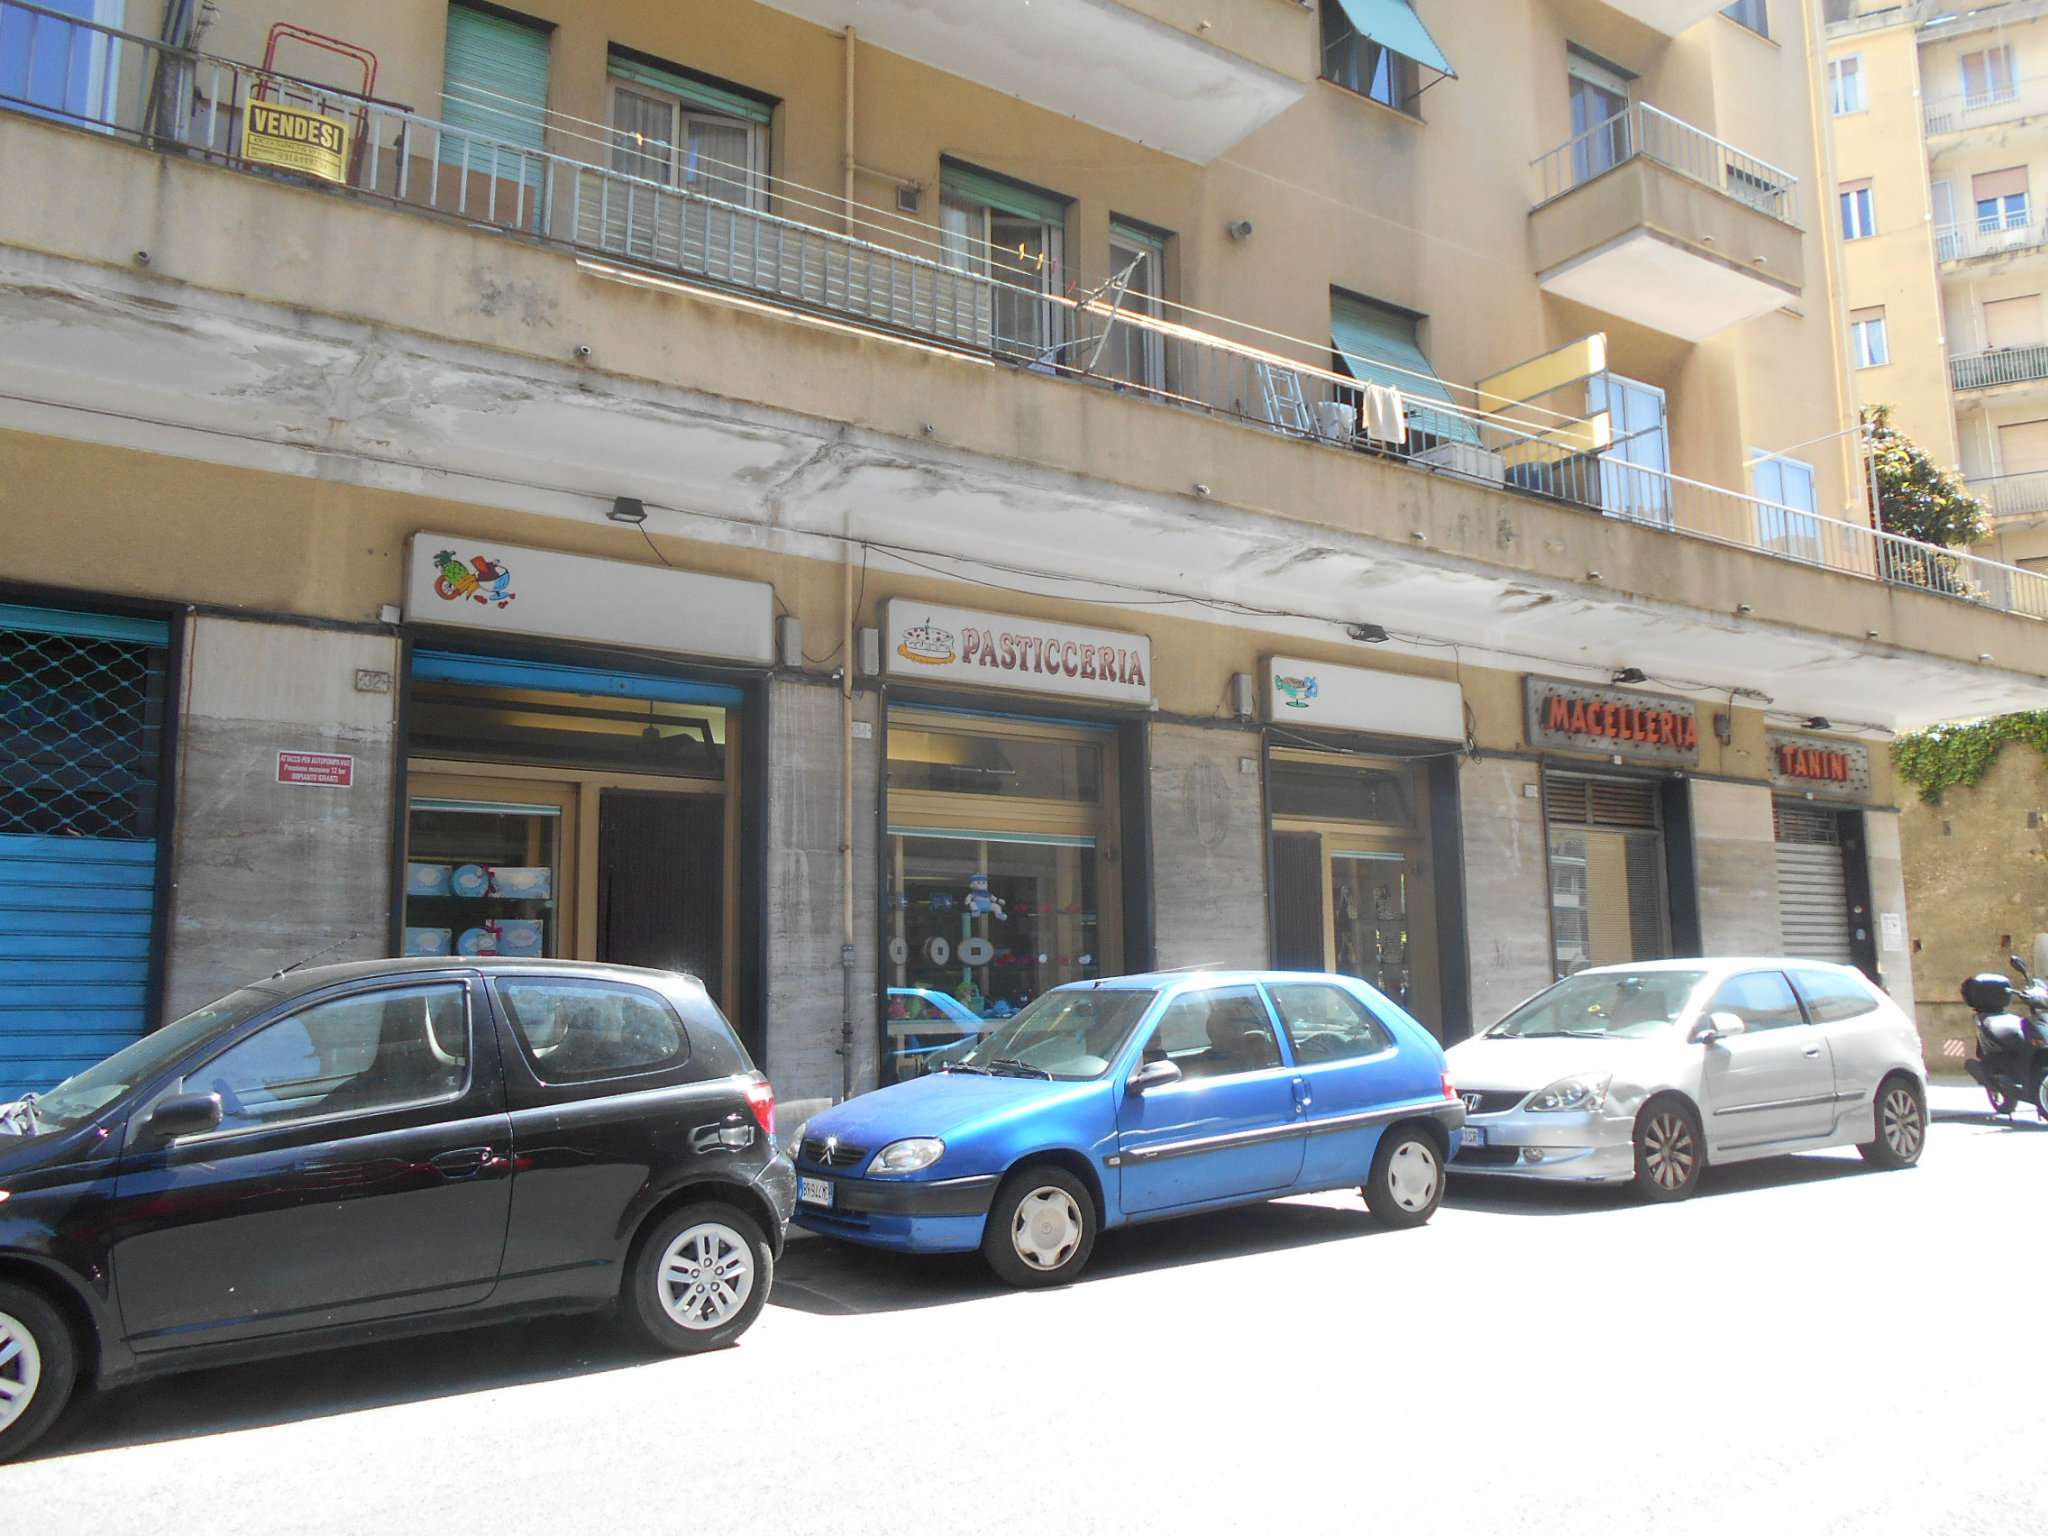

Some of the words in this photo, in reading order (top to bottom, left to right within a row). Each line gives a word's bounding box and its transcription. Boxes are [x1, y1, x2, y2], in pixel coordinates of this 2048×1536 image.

[254, 107, 341, 152] VENDESI
[961, 627, 1146, 686] PASTICCERIA
[1548, 695, 1698, 751] MACELLERIA
